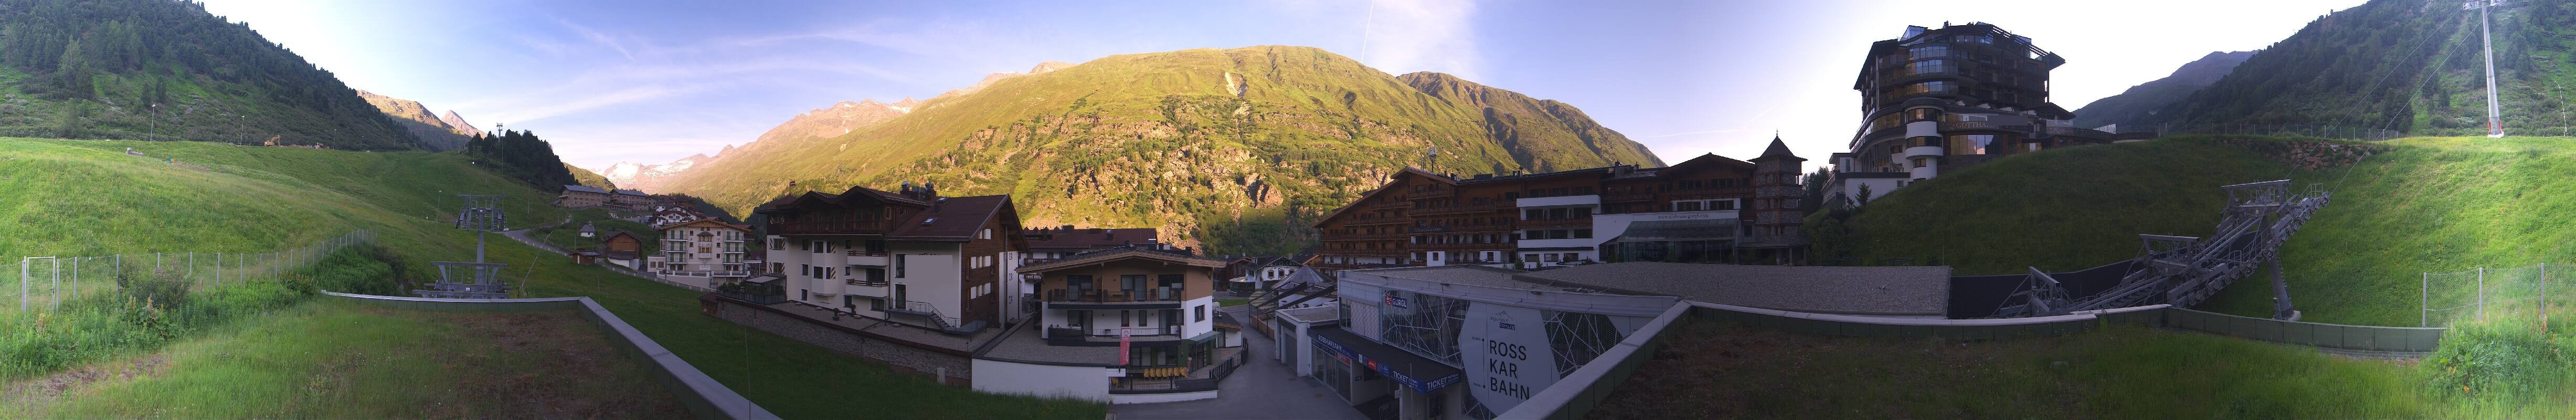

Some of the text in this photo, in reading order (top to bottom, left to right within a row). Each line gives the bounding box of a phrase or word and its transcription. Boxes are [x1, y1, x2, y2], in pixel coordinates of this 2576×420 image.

[1392, 298, 1407, 307] GURGL
[1318, 334, 1342, 352] ROSSKARBAHN
[1490, 340, 1526, 361] ROSS
[1393, 371, 1408, 383] TICKET
[1490, 358, 1518, 379] KAR
[1427, 377, 1447, 390] TICKET
[1490, 377, 1530, 400] BAHN
